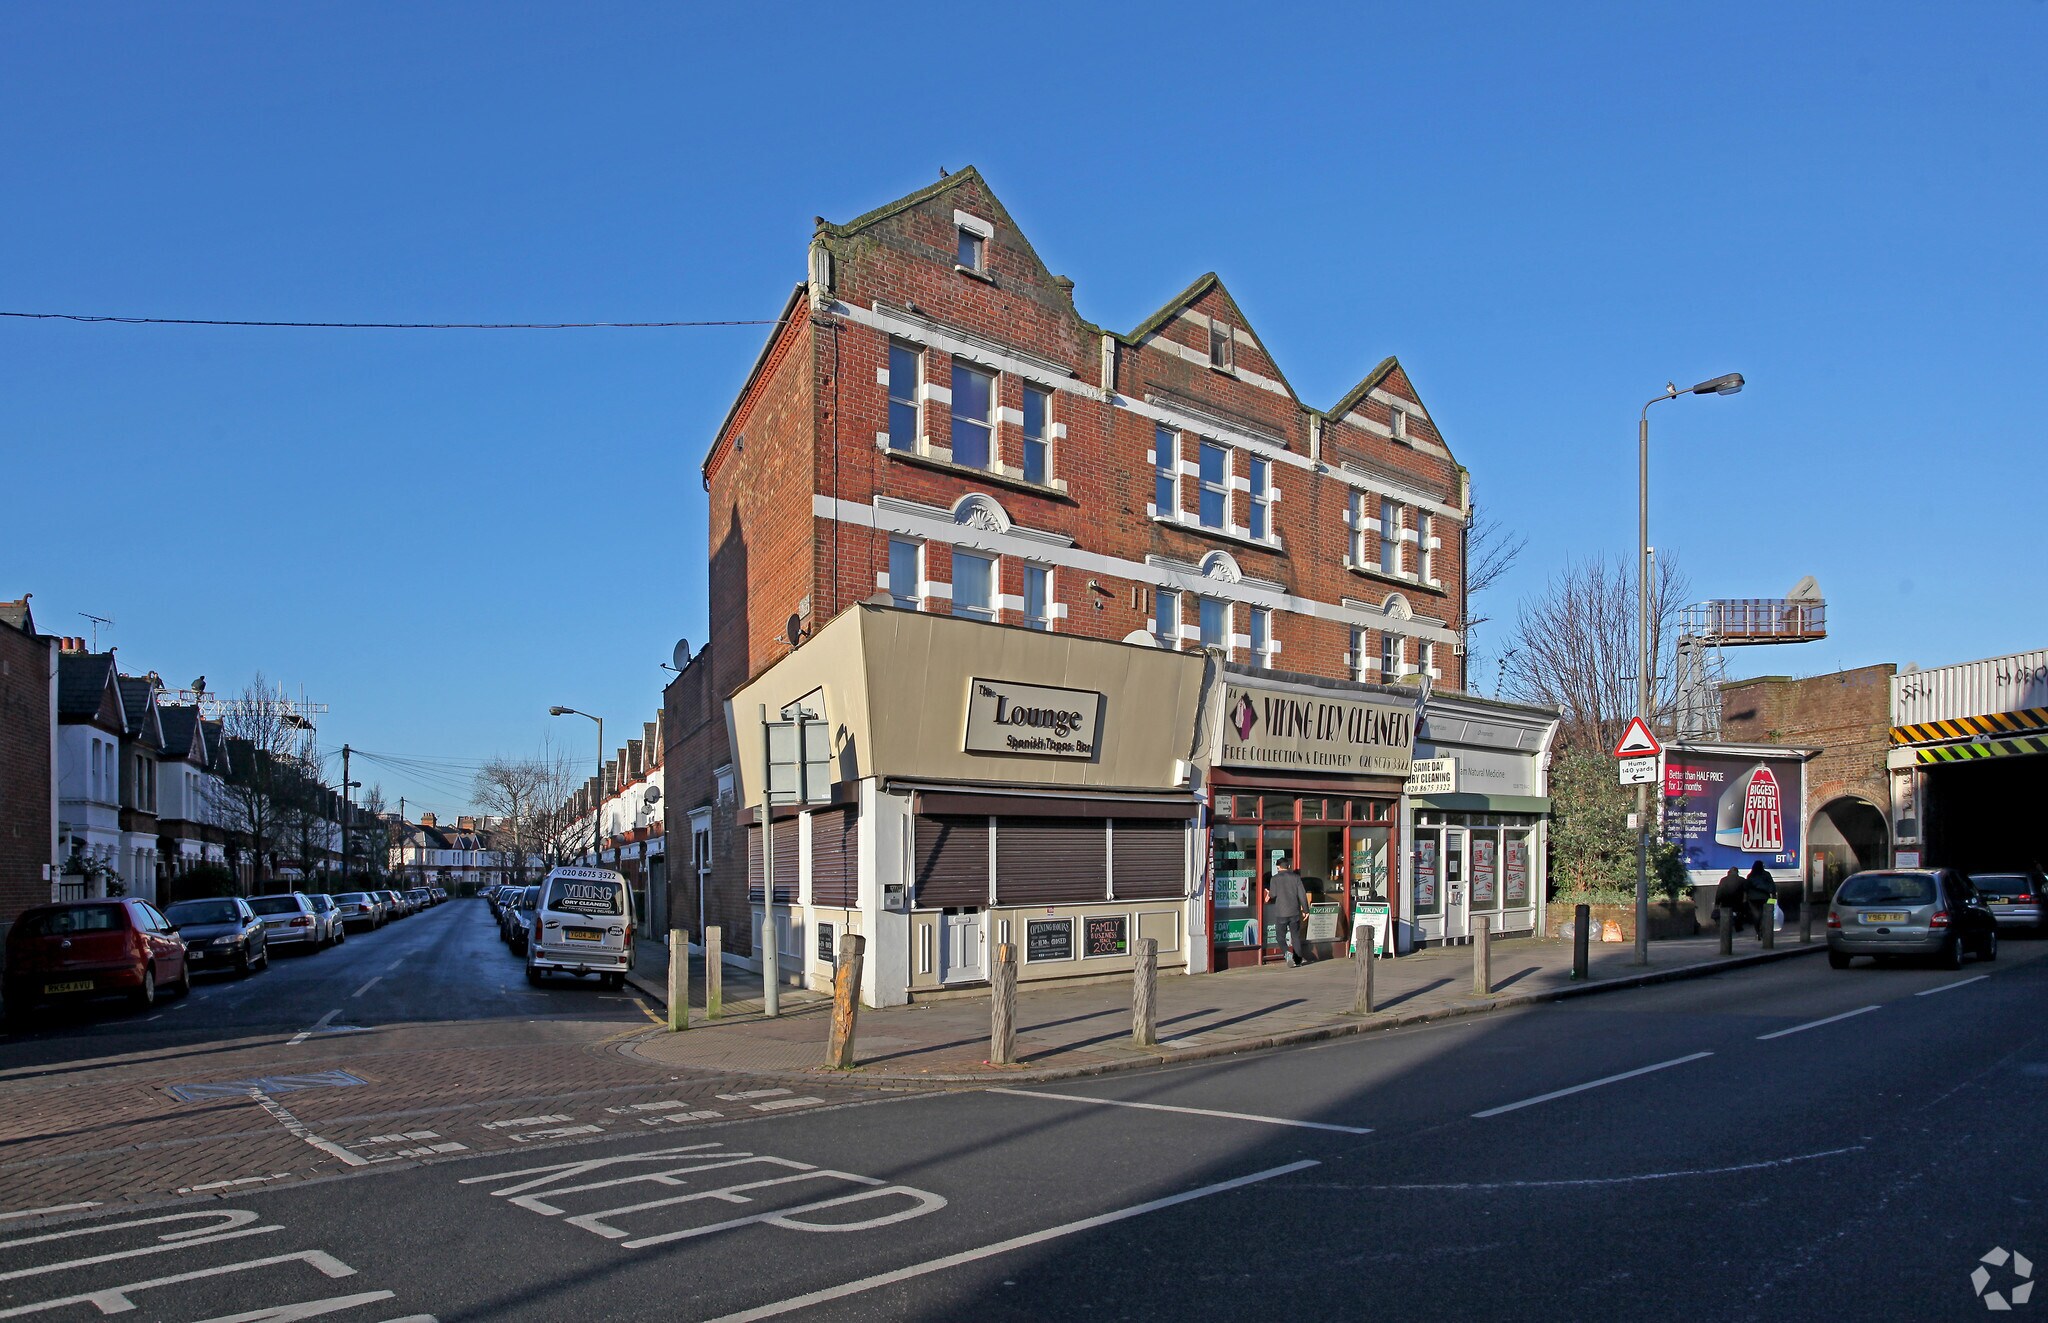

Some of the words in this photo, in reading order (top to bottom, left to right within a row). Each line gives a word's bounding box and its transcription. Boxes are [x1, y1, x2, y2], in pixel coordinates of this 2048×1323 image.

[1228, 688, 1237, 699] 74
[993, 695, 1082, 737] Lounge
[1264, 697, 1314, 740] VIKING
[1316, 704, 1347, 743] DRY
[1349, 706, 1411, 749] CLEANERS
[1006, 735, 1043, 750] Spanish
[1045, 737, 1073, 752] Tapas
[1076, 740, 1091, 752] Bar
[1224, 744, 1247, 761] FREE
[1250, 745, 1303, 764] COLLECTION
[1305, 753, 1310, 764] &
[1313, 750, 1352, 767] DELIVERY
[1359, 754, 1373, 768] 020
[1392, 758, 1409, 771] 3322
[1413, 762, 1430, 772] SAME
[1432, 761, 1444, 771] DAY
[1421, 772, 1451, 783] CLEANING
[1469, 767, 1484, 777] Natural
[1486, 769, 1505, 779] Medicine
[1669, 769, 1683, 780] Better
[1685, 771, 1696, 780] than
[1696, 771, 1709, 781] HALF
[1710, 772, 1724, 781] PRICE
[1435, 783, 1450, 791] 3322
[1677, 781, 1683, 790] 12
[1684, 782, 1702, 791] months
[1750, 785, 1775, 796] BIGGEST
[1748, 796, 1766, 809] EVER
[1767, 797, 1776, 809] BT
[1743, 809, 1781, 849] SALE
[1775, 854, 1786, 863] BT
[577, 870, 596, 878] 8675
[598, 872, 616, 880] 3322
[1217, 880, 1236, 890] SHOE
[563, 883, 613, 900] VIKING
[1215, 891, 1239, 901] REPAIRS
[579, 900, 610, 908] CLEANERS
[1030, 923, 1052, 935] OPENING
[1052, 922, 1070, 932] HOURS
[1090, 921, 1120, 932] FAMILY
[1222, 930, 1243, 940] Cleaning
[1093, 941, 1117, 953] 2002
[458, 1142, 948, 1250] KEEP
